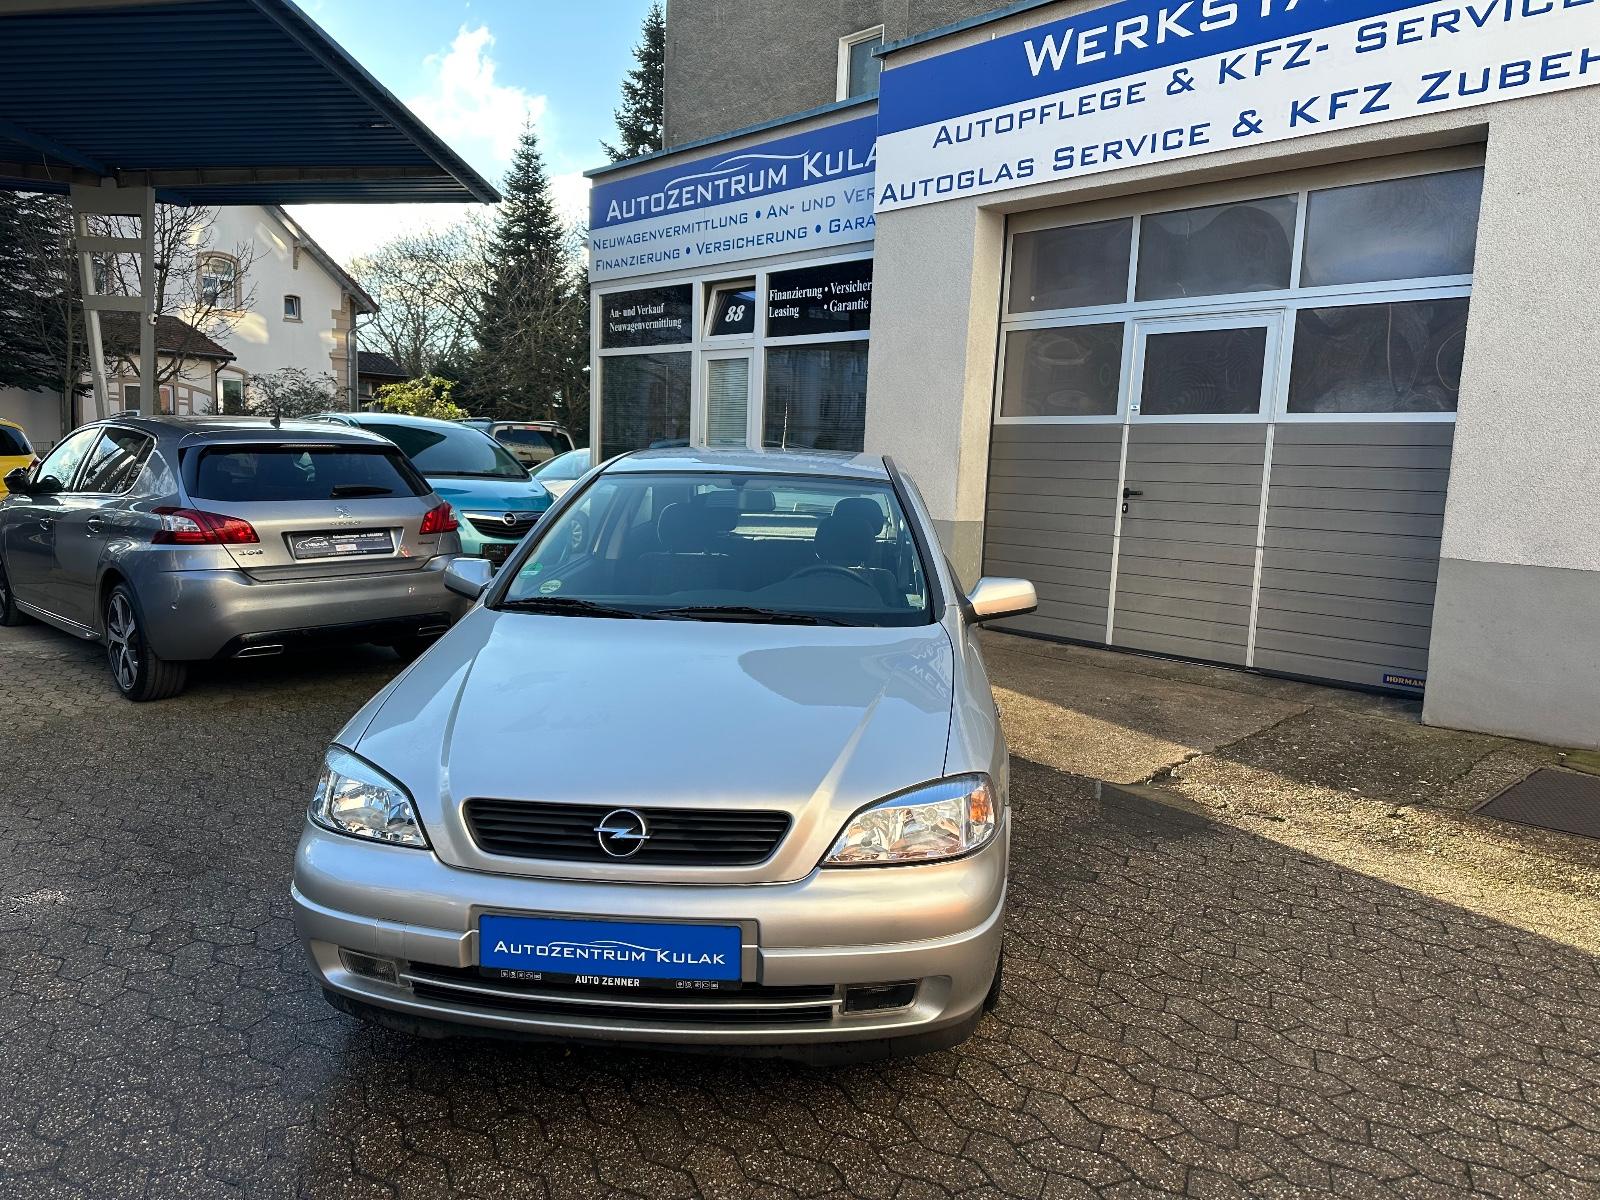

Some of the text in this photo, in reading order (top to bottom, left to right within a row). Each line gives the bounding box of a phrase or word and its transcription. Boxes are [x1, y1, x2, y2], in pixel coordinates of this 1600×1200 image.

[933, 81, 1146, 148] AUTOPFLEGE
[1166, 68, 1195, 96] &
[1219, 38, 1329, 84] KFZ-
[879, 158, 1034, 205] AUTOGLAS
[1053, 123, 1210, 171] SERVICE
[1232, 109, 1264, 138] &
[1290, 82, 1392, 127] KFZ
[606, 164, 787, 222] AUTOZENTRUM
[593, 213, 748, 251] NEUWAGENVERMITTLUNG
[766, 205, 795, 219] AN-
[802, 196, 836, 212] UND
[596, 248, 680, 271] FINANZIERUNG
[696, 227, 807, 255] VERSICHERUNG
[769, 287, 823, 301] Finanzierung
[609, 302, 665, 319] An- und Verkauf
[725, 304, 746, 322] 88
[769, 297, 869, 319] Leasing Garantie
[609, 318, 682, 334] Neuwagenvermittlung
[494, 940, 726, 965] AUTOZENTRUM KULAK
[575, 974, 640, 987] AUTO ZENNER
